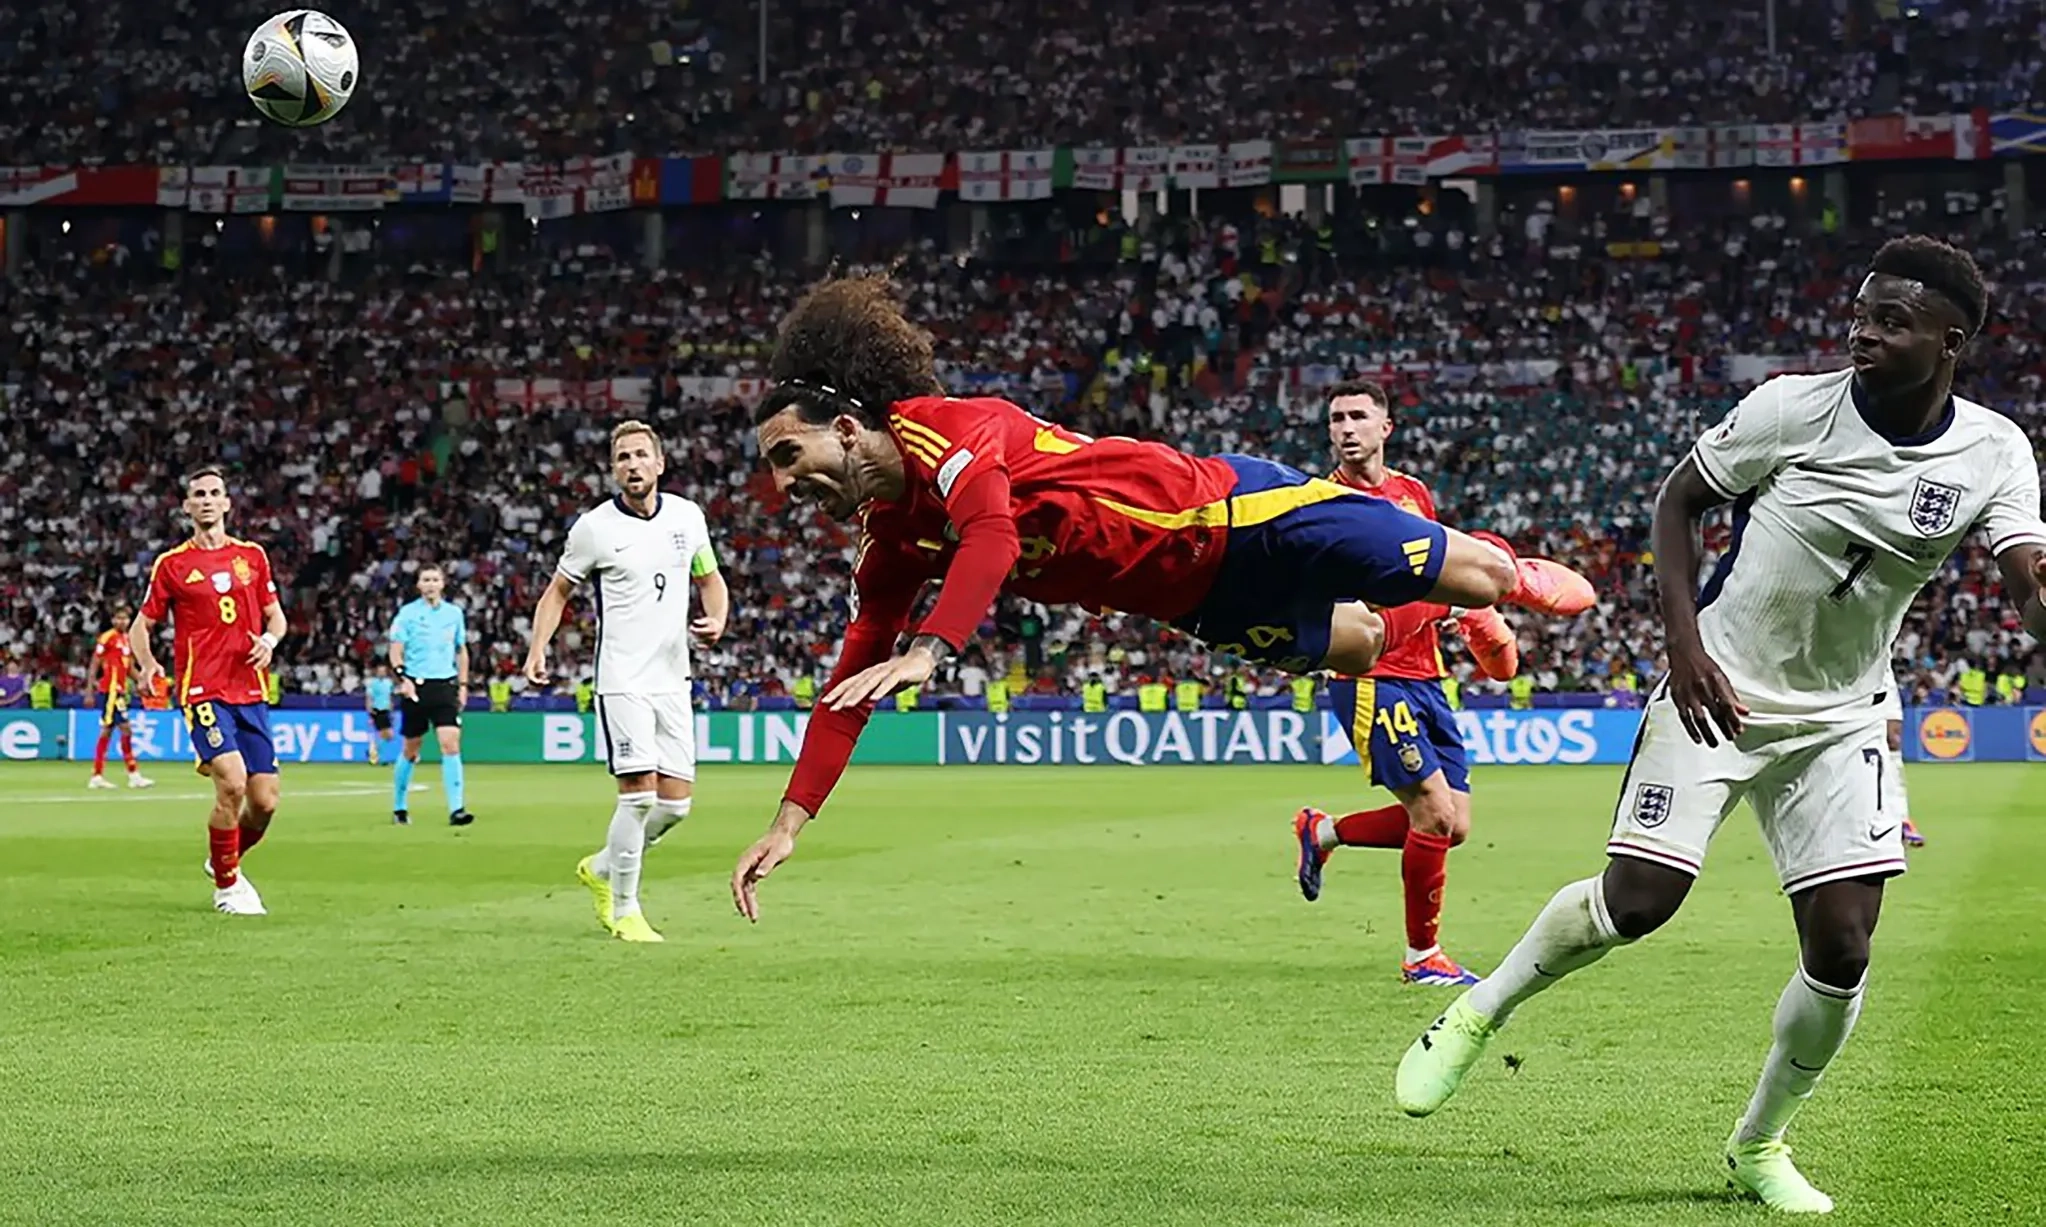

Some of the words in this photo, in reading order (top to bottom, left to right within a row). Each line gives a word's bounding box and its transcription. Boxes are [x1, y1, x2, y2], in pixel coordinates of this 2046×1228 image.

[653, 572, 667, 602] 9
[1828, 541, 1876, 599] 7
[219, 596, 237, 624] 8
[196, 702, 216, 727] 8
[1376, 701, 1418, 744] 14
[543, 713, 807, 762] BLIN
[1862, 748, 1884, 811] 7
